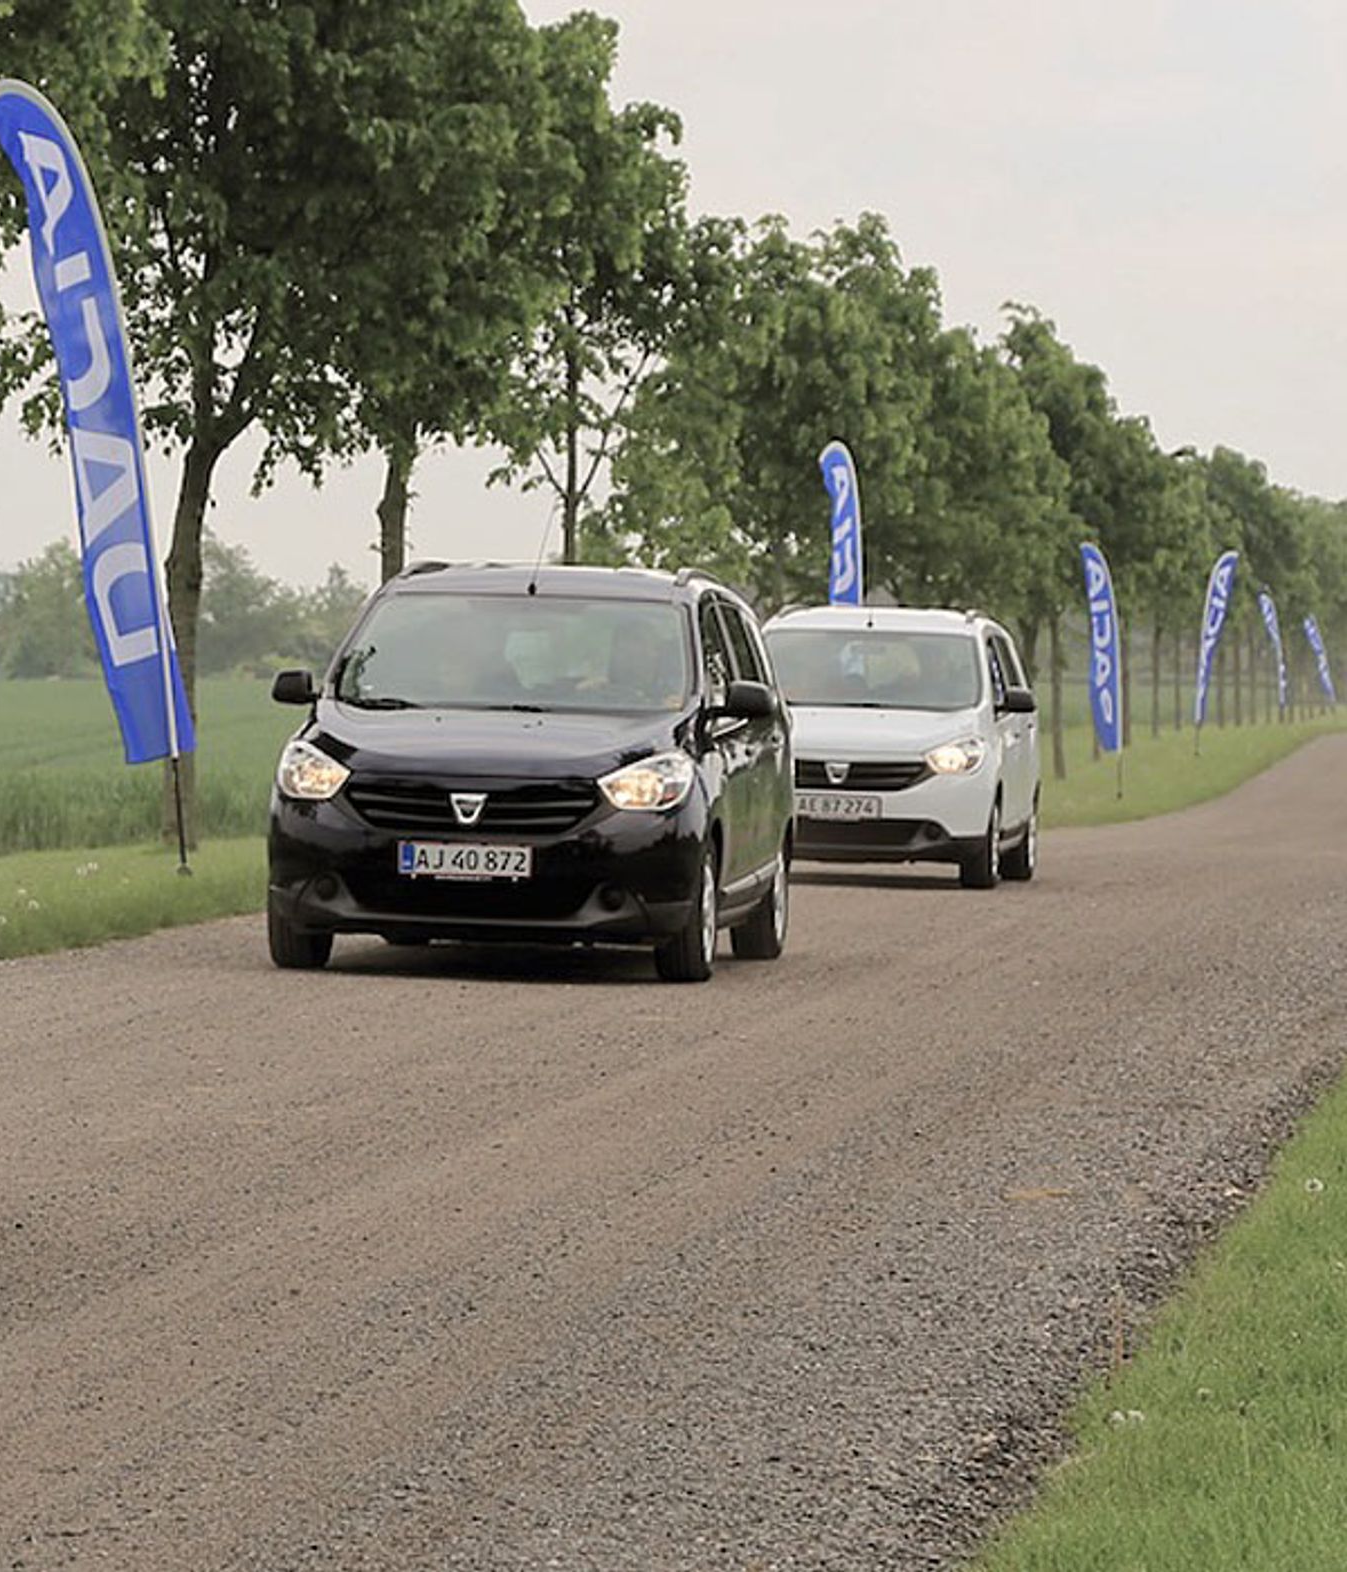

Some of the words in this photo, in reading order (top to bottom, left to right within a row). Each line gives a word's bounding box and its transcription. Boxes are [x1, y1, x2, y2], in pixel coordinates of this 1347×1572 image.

[844, 798, 874, 815] 274
[416, 848, 445, 870] AJ
[451, 849, 479, 871] 40
[484, 851, 527, 873] 872
